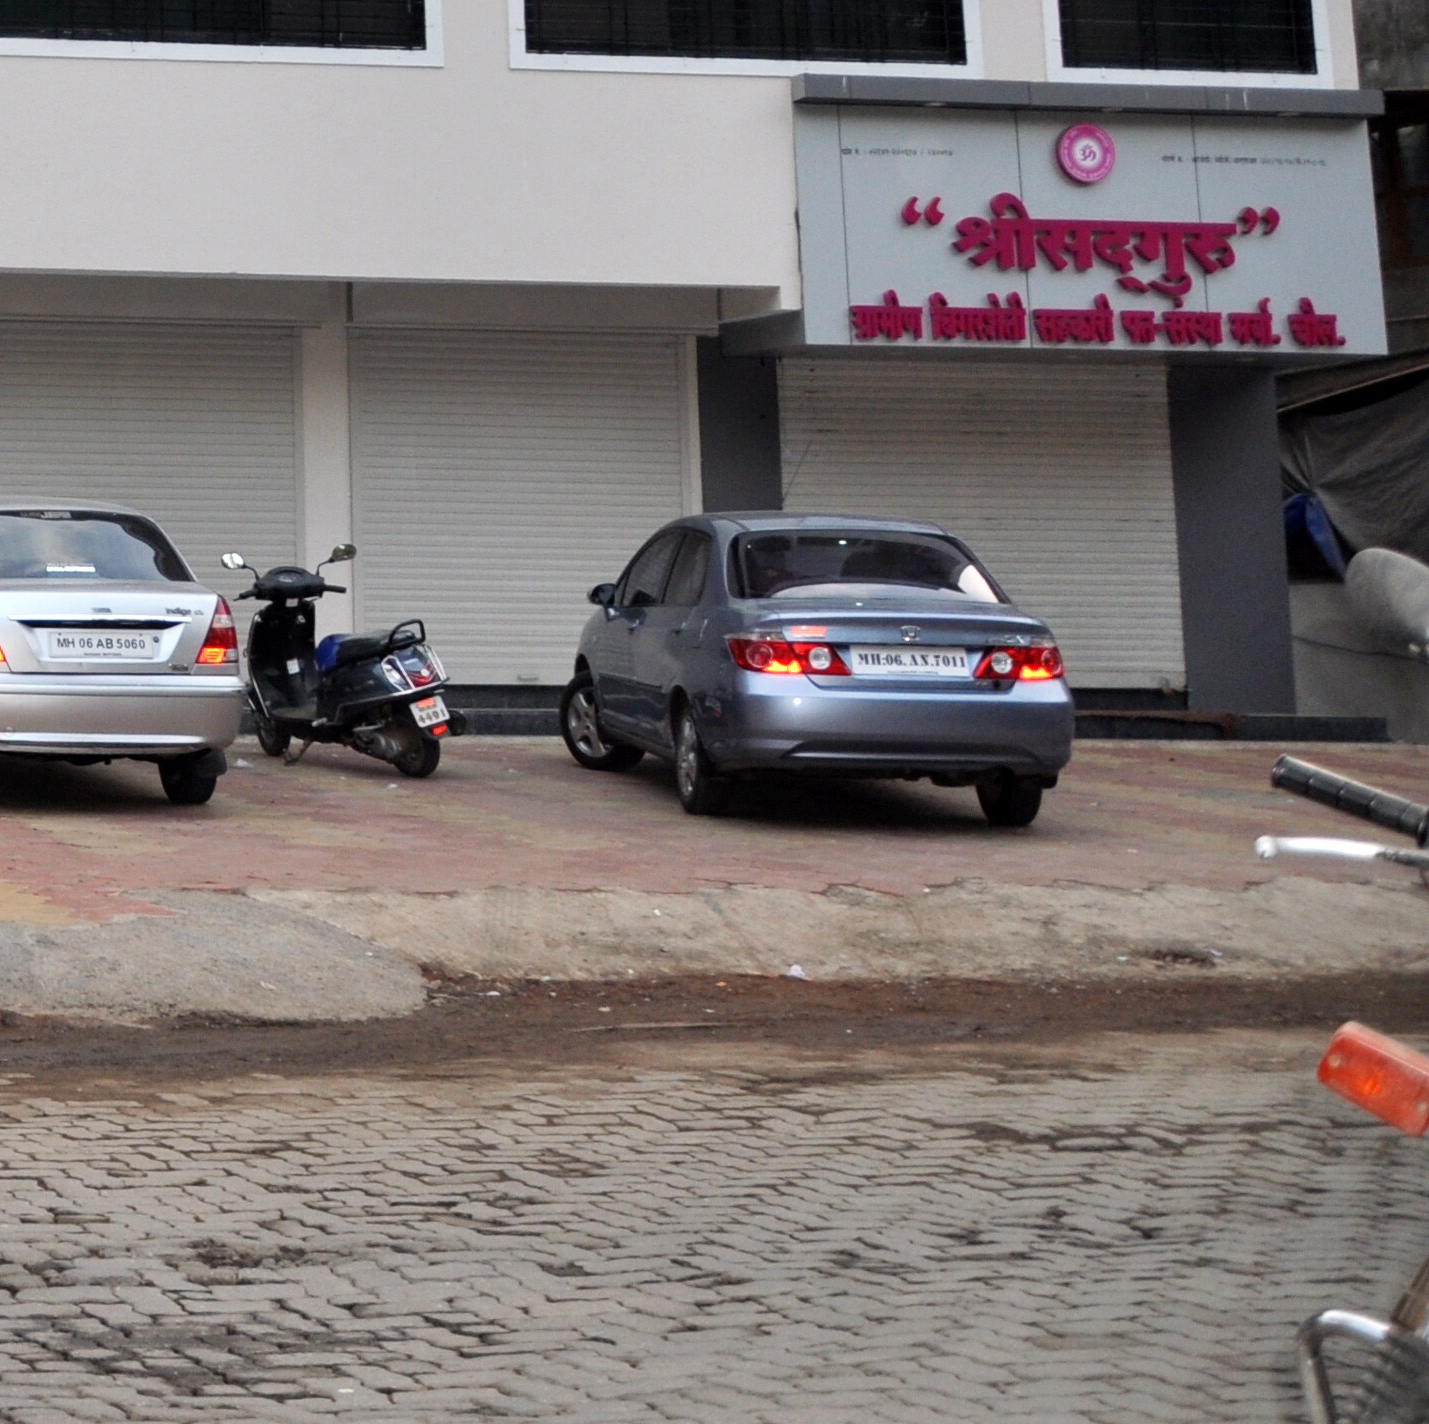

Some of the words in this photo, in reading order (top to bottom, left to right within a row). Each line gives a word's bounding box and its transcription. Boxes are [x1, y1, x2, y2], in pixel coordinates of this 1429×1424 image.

[57, 638, 75, 648] MH
[79, 638, 94, 649] 06
[96, 638, 114, 650] AB
[117, 639, 146, 650] 5060
